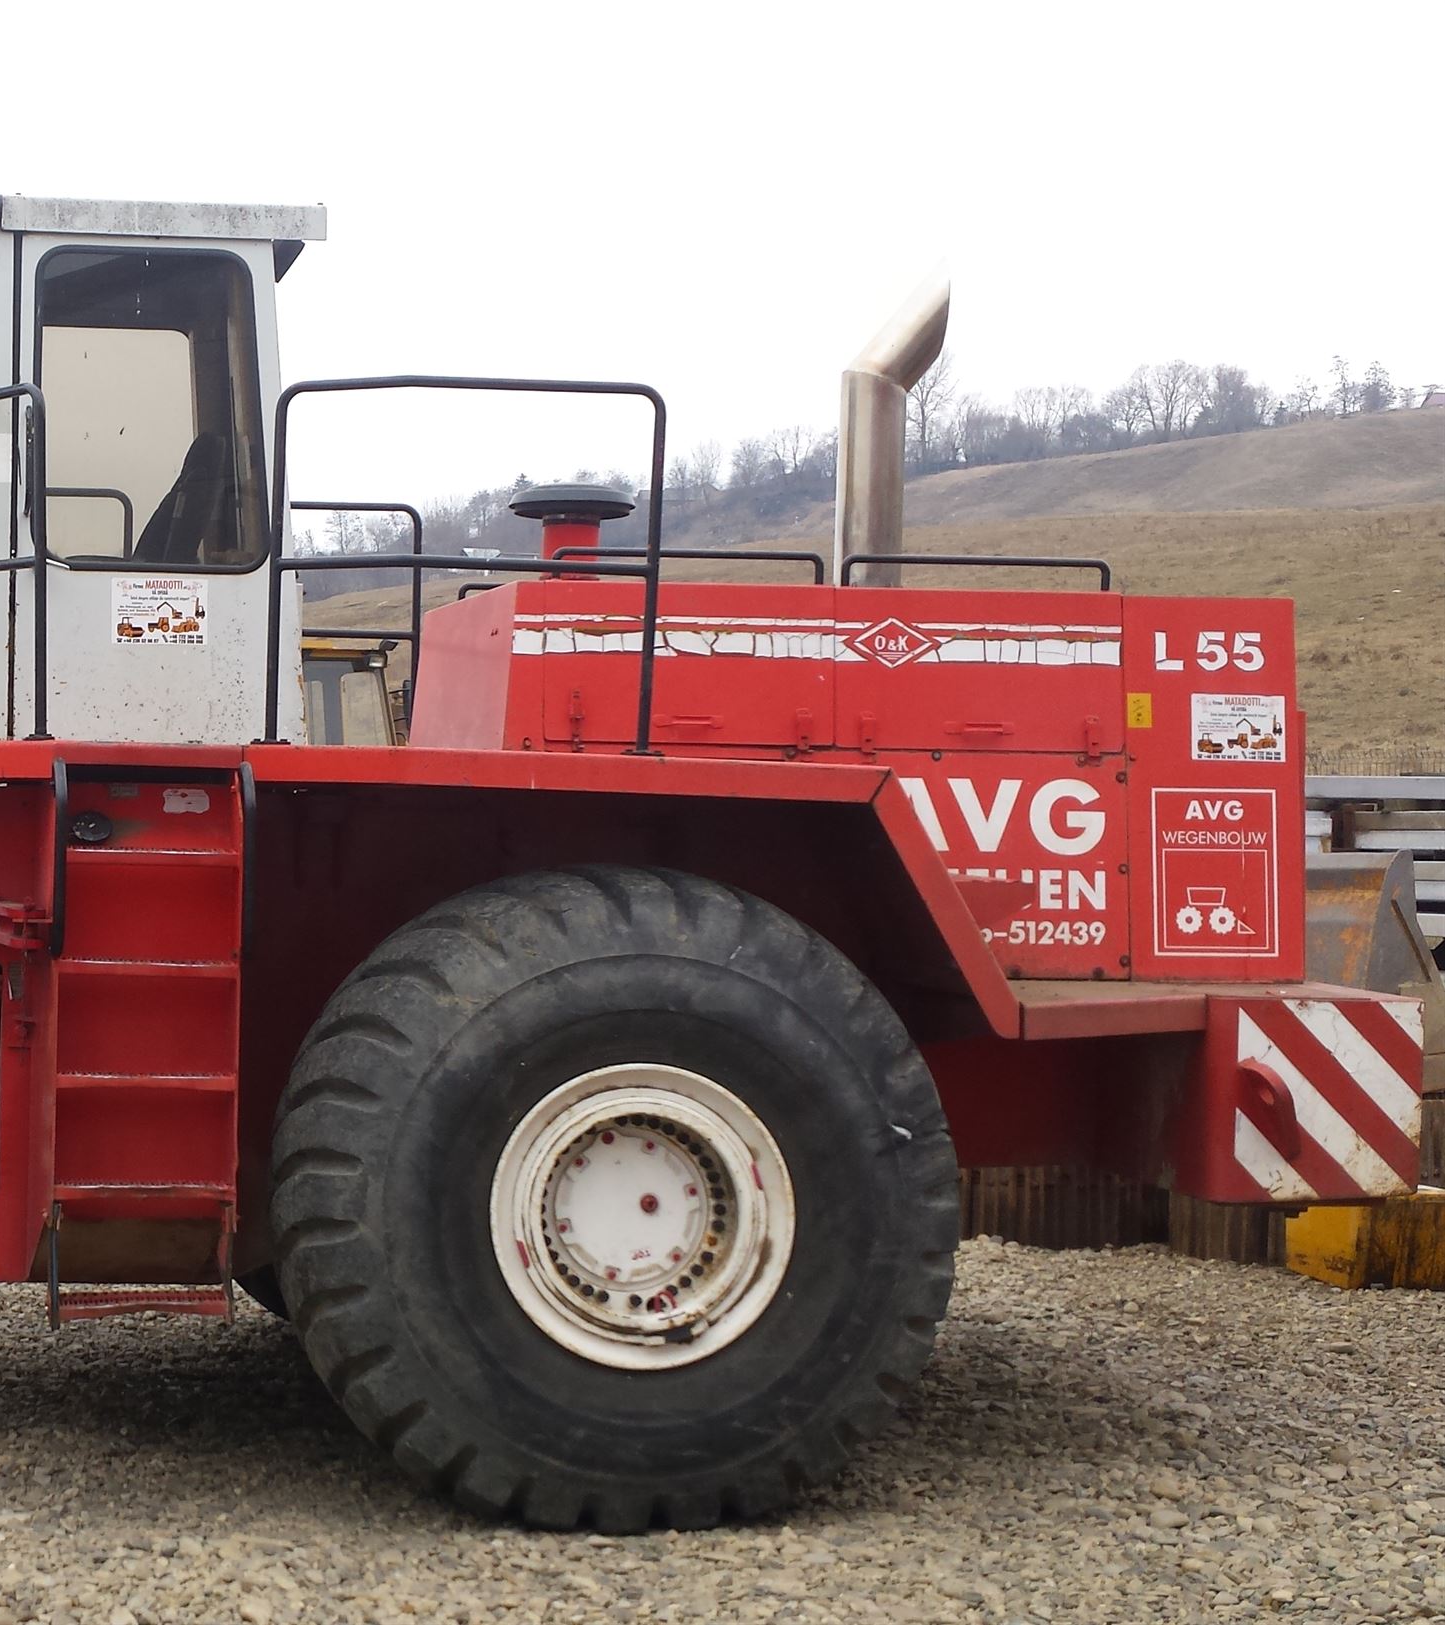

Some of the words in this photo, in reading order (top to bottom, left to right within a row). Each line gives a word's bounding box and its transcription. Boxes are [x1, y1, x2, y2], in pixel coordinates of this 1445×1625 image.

[145, 580, 183, 590] MATADOTTI
[874, 635, 910, 652] O&K
[1154, 631, 1185, 671] L
[1196, 631, 1265, 672] 55
[1185, 799, 1245, 821] AVG
[1162, 830, 1267, 845] WEGENBOUW
